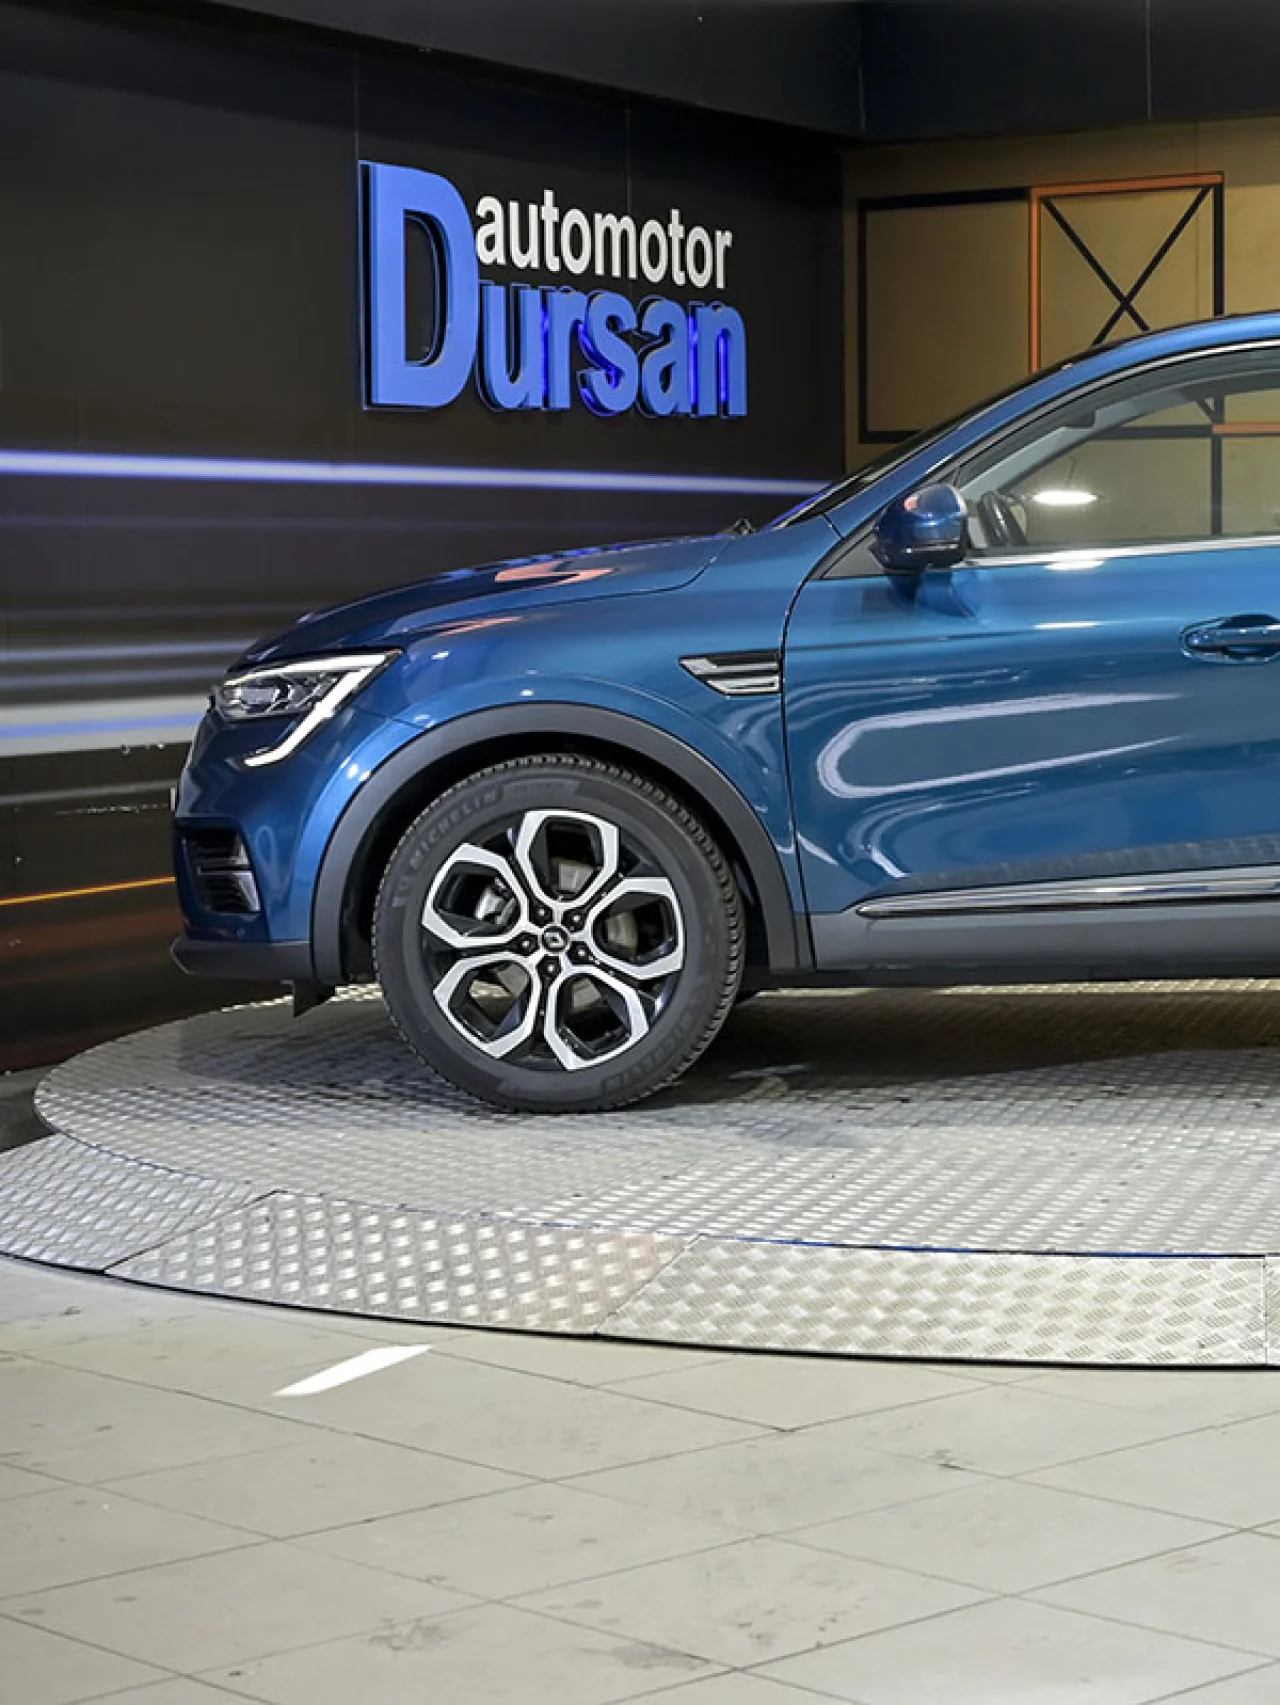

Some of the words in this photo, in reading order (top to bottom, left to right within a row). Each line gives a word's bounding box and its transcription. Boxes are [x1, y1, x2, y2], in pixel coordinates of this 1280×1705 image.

[358, 159, 747, 417] Dursan
[475, 189, 733, 289] automotor
[408, 788, 498, 870] MICHELIN
